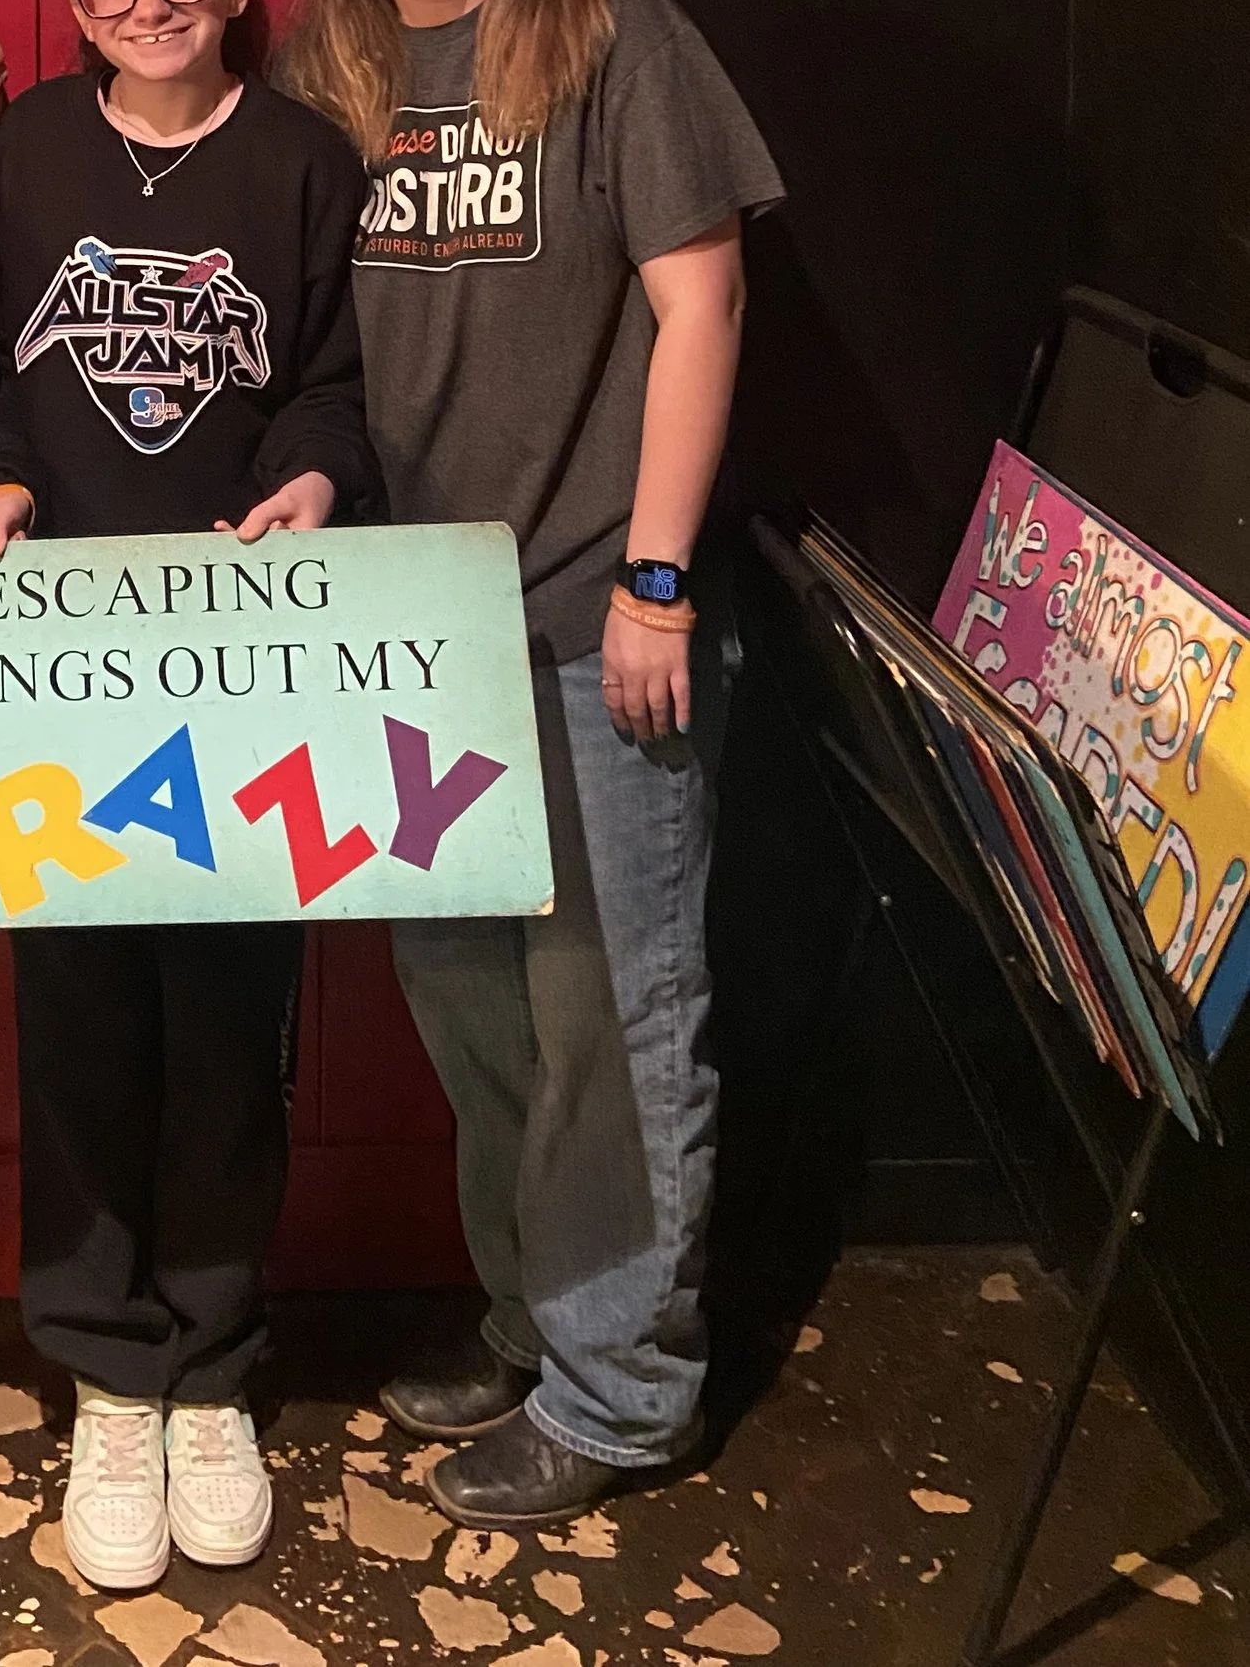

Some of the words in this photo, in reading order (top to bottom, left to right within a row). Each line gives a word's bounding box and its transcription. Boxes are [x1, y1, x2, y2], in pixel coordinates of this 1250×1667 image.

[387, 128, 437, 159] ase
[463, 233, 524, 249] ALREADY
[85, 326, 214, 391] JAM
[129, 387, 165, 427] 9
[978, 478, 1048, 590] We
[158, 642, 308, 699] OUT
[334, 637, 449, 692] MY
[1045, 534, 1243, 793] almost
